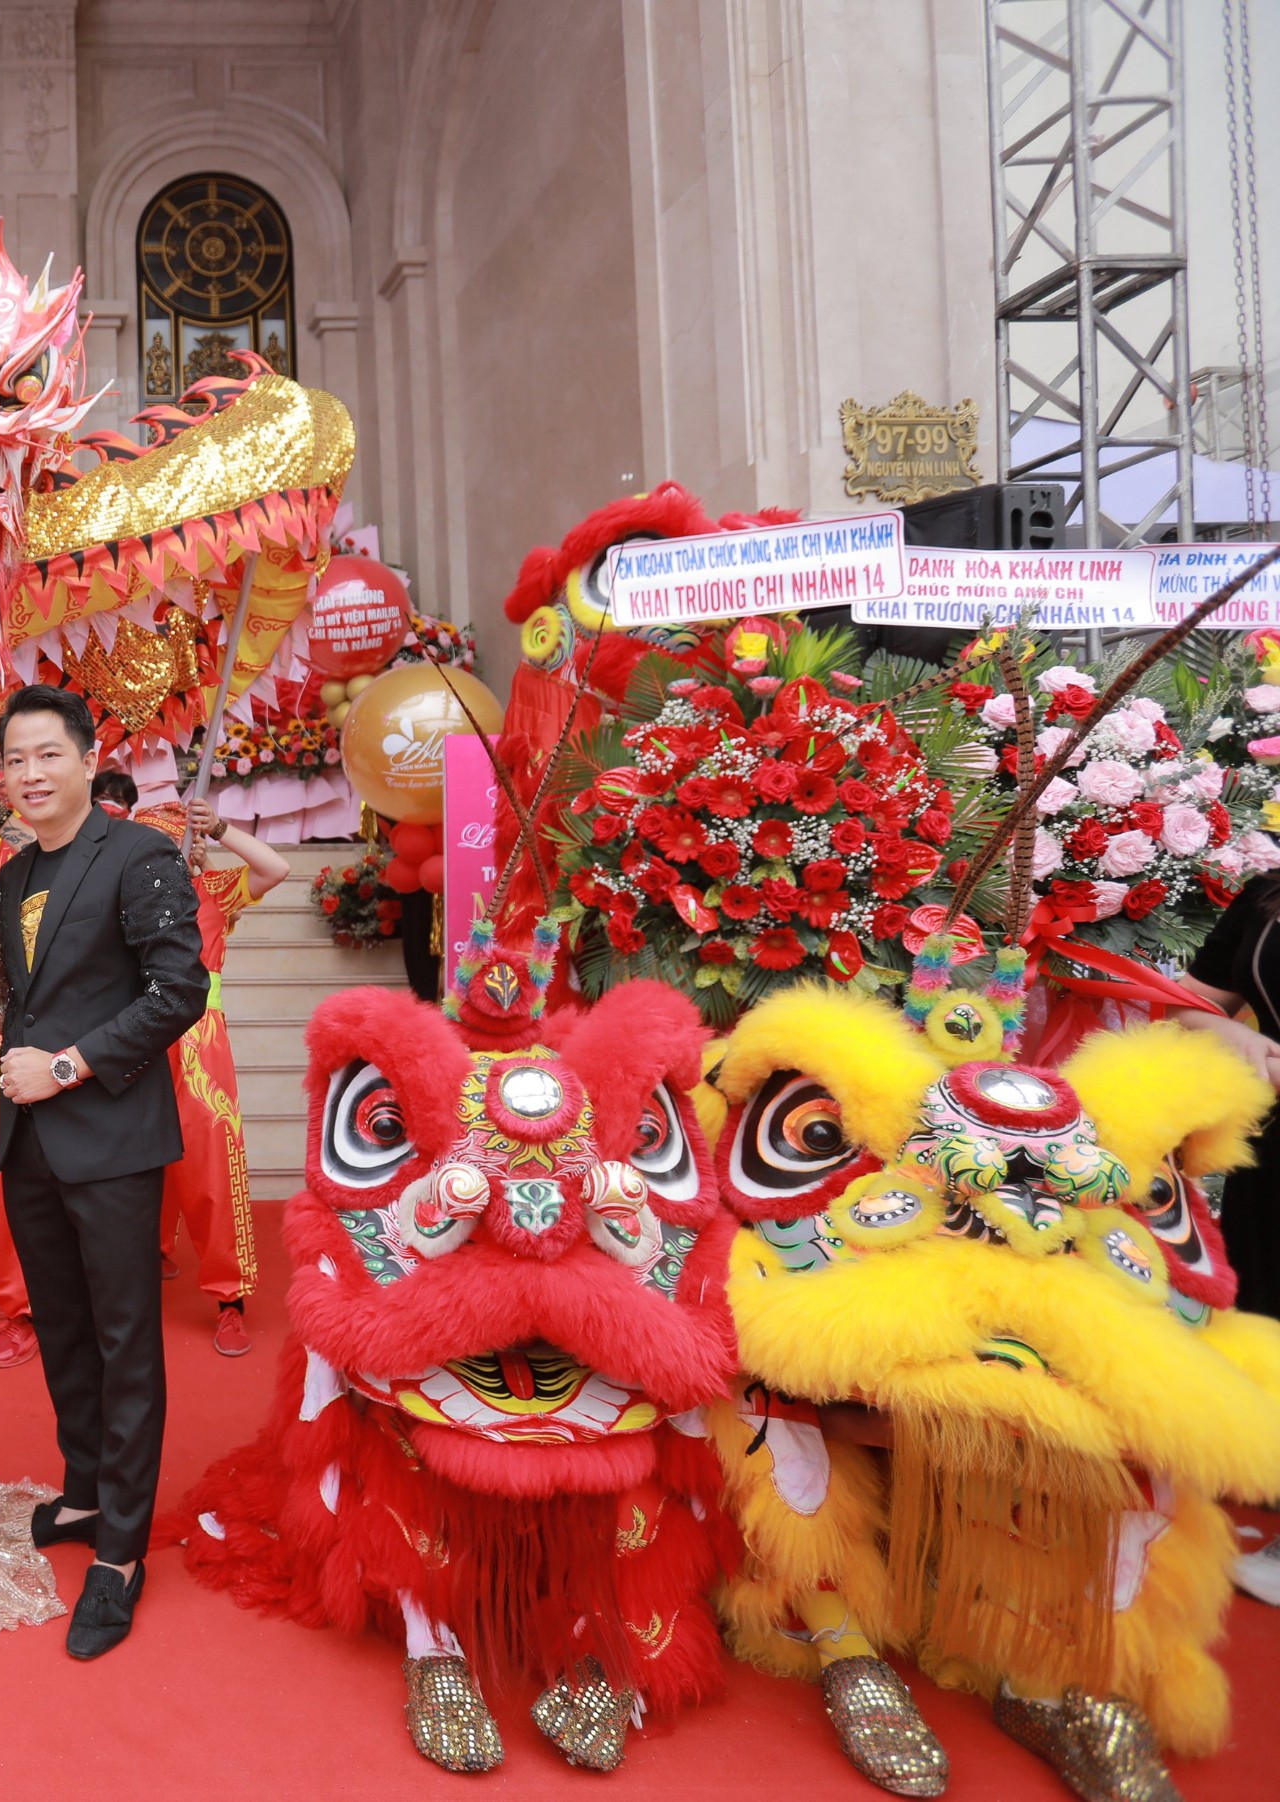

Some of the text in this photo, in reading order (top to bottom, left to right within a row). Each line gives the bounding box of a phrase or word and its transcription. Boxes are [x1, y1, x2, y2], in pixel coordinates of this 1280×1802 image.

[876, 425, 949, 455] 97-99
[934, 461, 960, 476] LINH
[709, 541, 737, 569] CHÚC
[740, 537, 772, 565] MỪNG
[775, 536, 799, 560] ANH
[825, 528, 847, 555] MAI
[851, 521, 894, 552] KHÁNH
[909, 557, 1123, 581] DANH HÒA KHÁNH LINH
[630, 563, 885, 619] KHAI TRƯƠNG CHI NHÁNH 14
[907, 580, 950, 597] CHÚC
[957, 582, 1008, 598] MỪNG
[1015, 585, 1049, 600] ANH
[1159, 573, 1197, 594] MỪNG
[367, 606, 400, 620] MAILISA
[867, 601, 907, 619] KHAI
[1036, 602, 1105, 625] NHÁNH
[1112, 607, 1135, 622] 14
